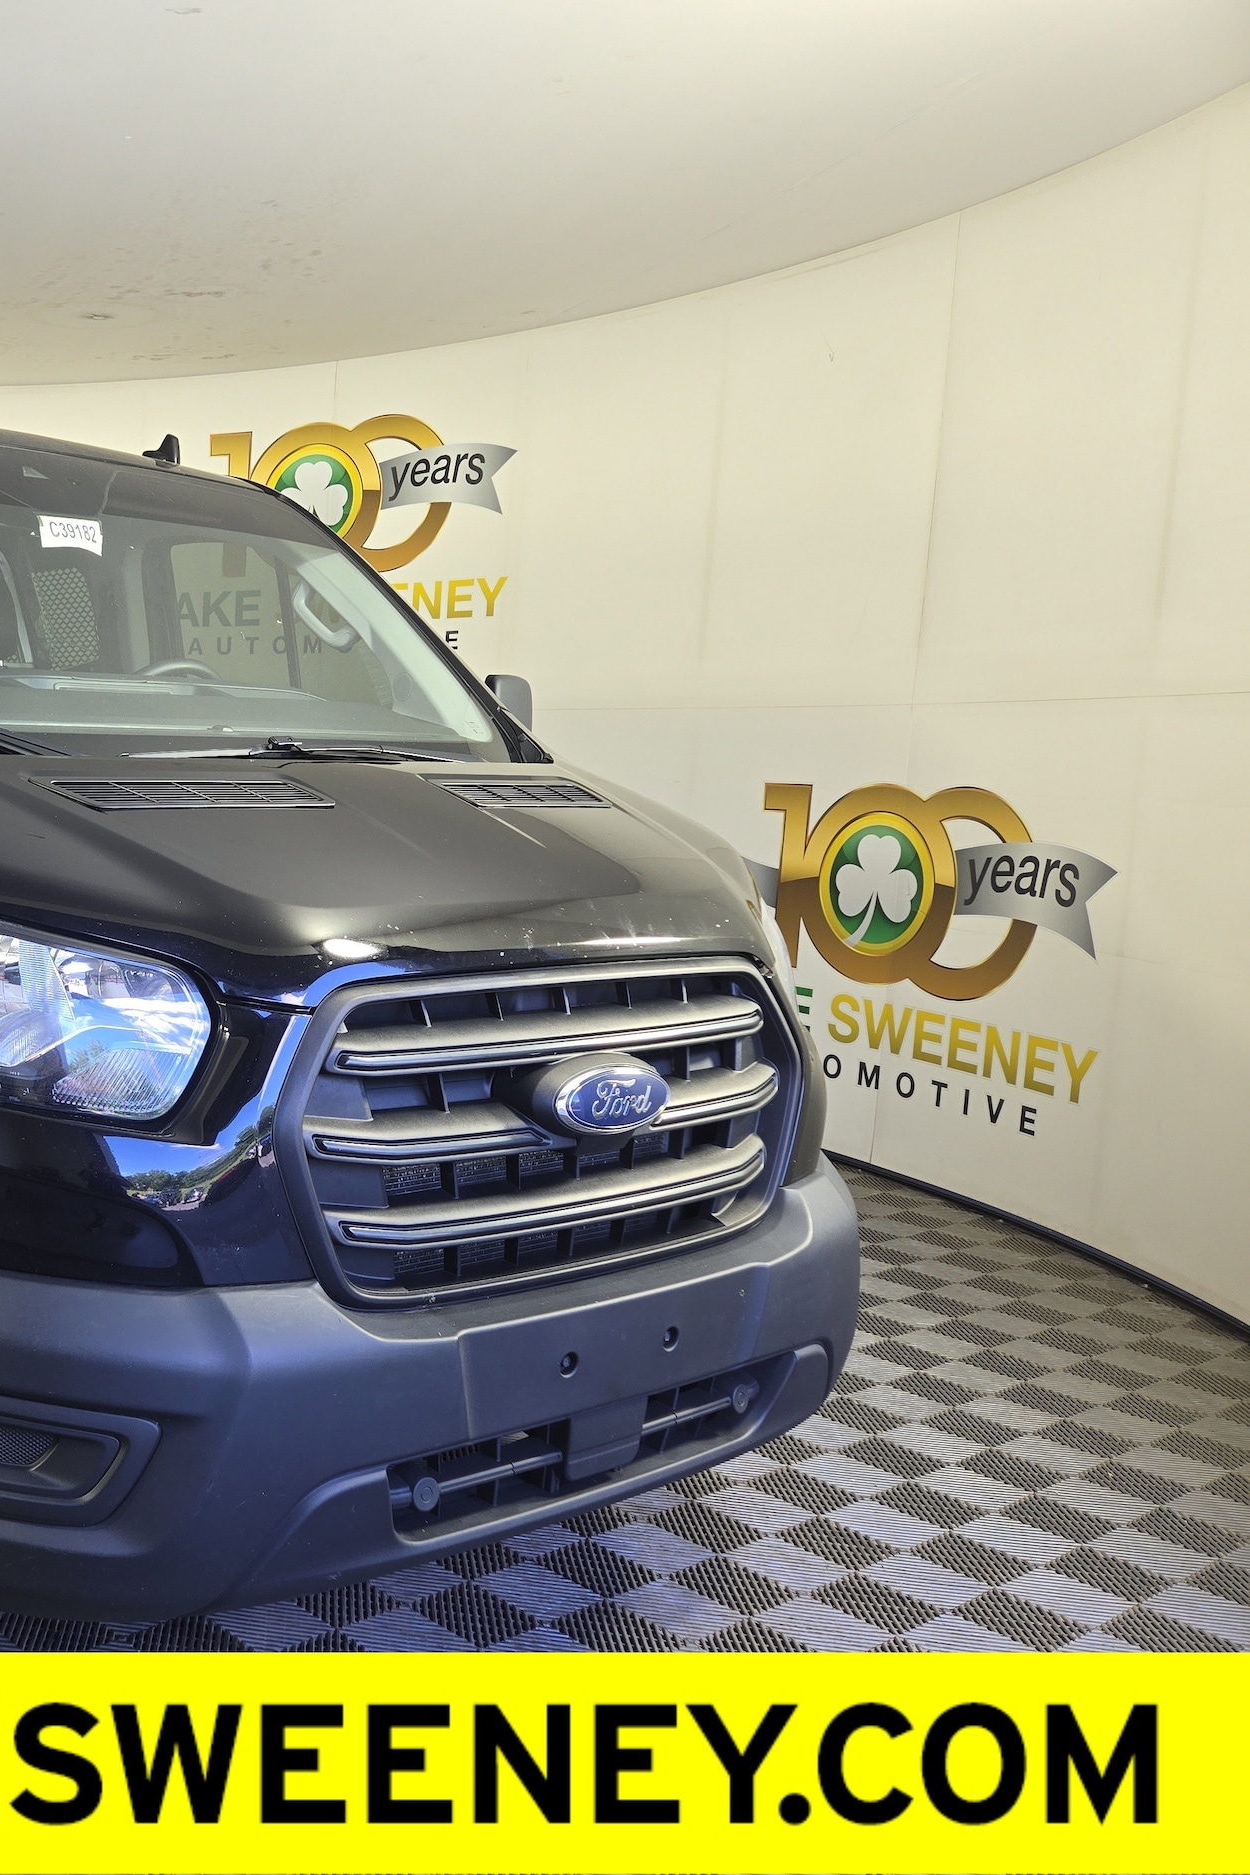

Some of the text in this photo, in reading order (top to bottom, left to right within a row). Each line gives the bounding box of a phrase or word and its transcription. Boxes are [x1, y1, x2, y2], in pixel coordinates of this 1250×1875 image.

[389, 452, 486, 501] years
[49, 521, 97, 543] C39182
[177, 589, 262, 628] AKE
[963, 855, 1080, 908] years
[828, 993, 1100, 1104] SWEENEY
[591, 1078, 653, 1121] Ford
[823, 1054, 1038, 1137] OMOTIVE
